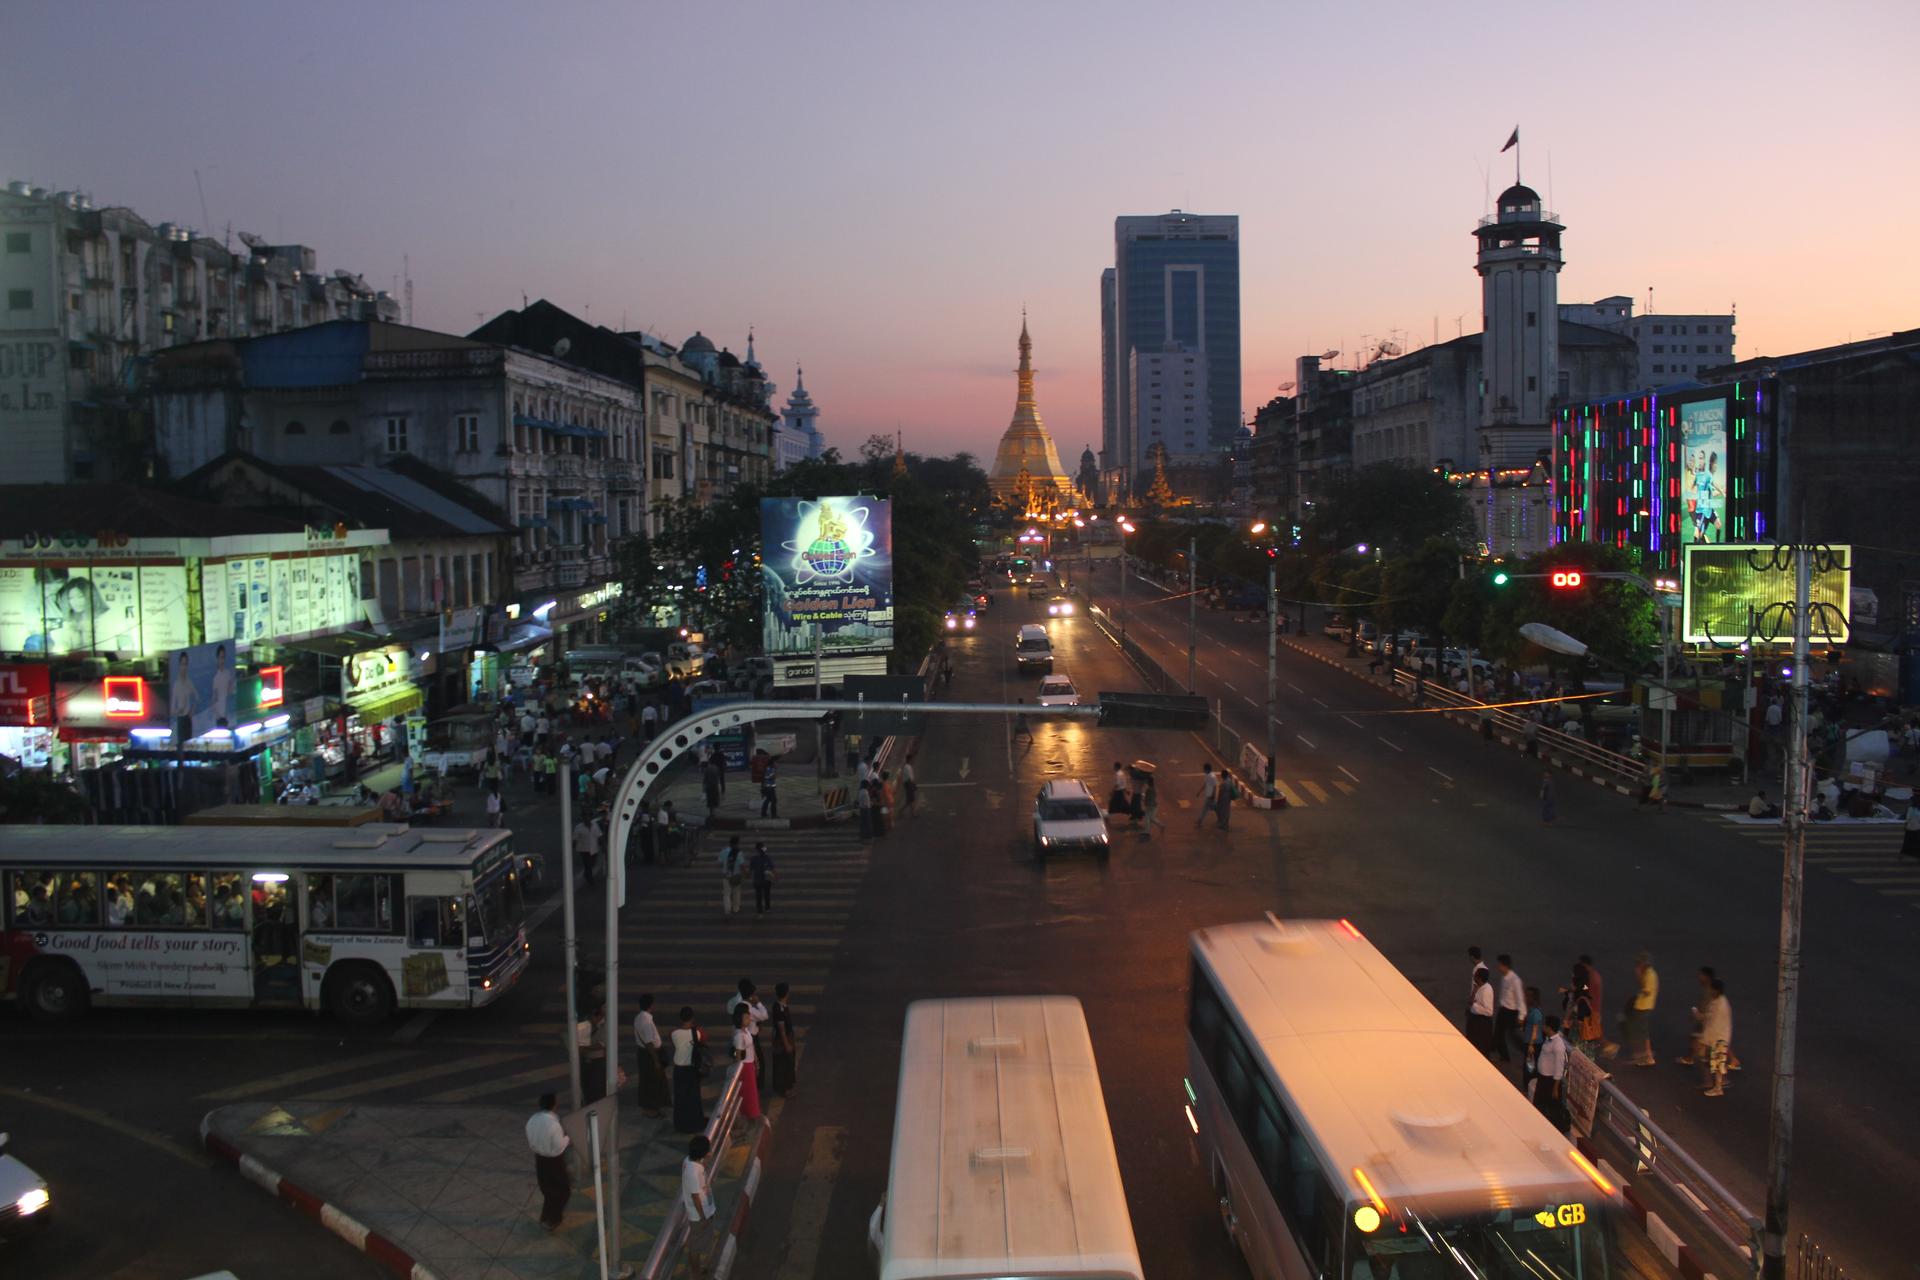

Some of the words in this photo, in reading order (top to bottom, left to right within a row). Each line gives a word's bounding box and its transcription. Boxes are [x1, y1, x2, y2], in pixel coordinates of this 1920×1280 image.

[783, 597, 839, 611] Golden
[842, 595, 876, 609] Lion
[792, 612, 812, 621] Wire
[820, 611, 843, 619] Cable
[787, 667, 815, 677] ganad
[53, 934, 91, 950] Good
[92, 934, 127, 953] food
[130, 935, 160, 950] tells
[163, 939, 199, 954] your
[201, 939, 241, 956] story.
[125, 961, 147, 970] Milk
[151, 961, 186, 971] Powder
[120, 981, 152, 989] Product
[154, 981, 162, 989] of
[184, 982, 217, 990] Zealand
[1557, 1203, 1586, 1226] GB
